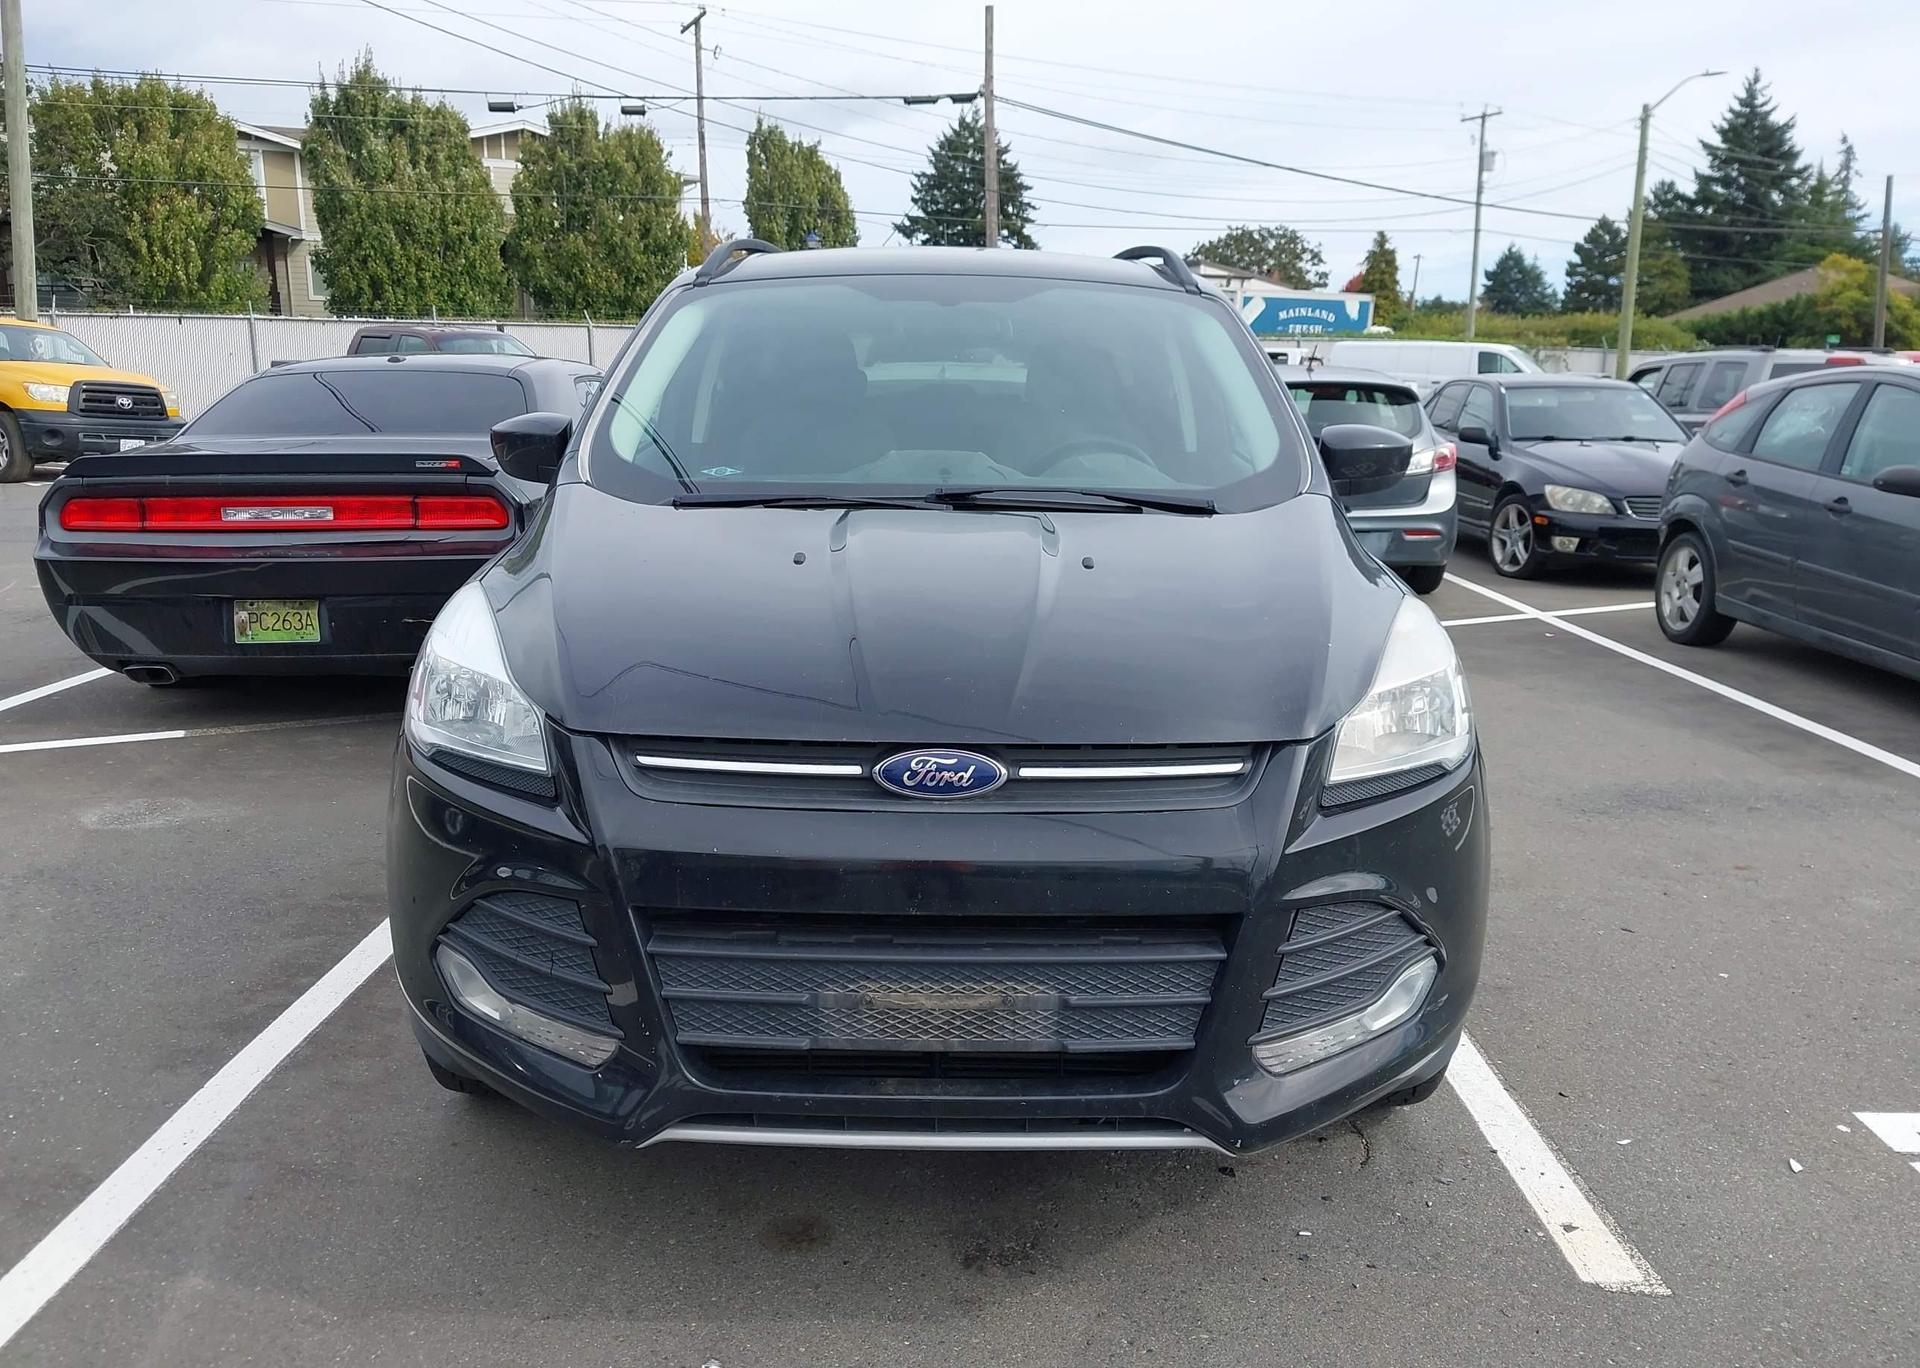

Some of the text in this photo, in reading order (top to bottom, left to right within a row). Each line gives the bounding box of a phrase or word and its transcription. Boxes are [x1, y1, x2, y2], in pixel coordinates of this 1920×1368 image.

[1278, 306, 1336, 323] MAINLAND
[1288, 324, 1323, 334] FRESH
[248, 611, 315, 632] PC263A
[903, 756, 976, 787] Ford
